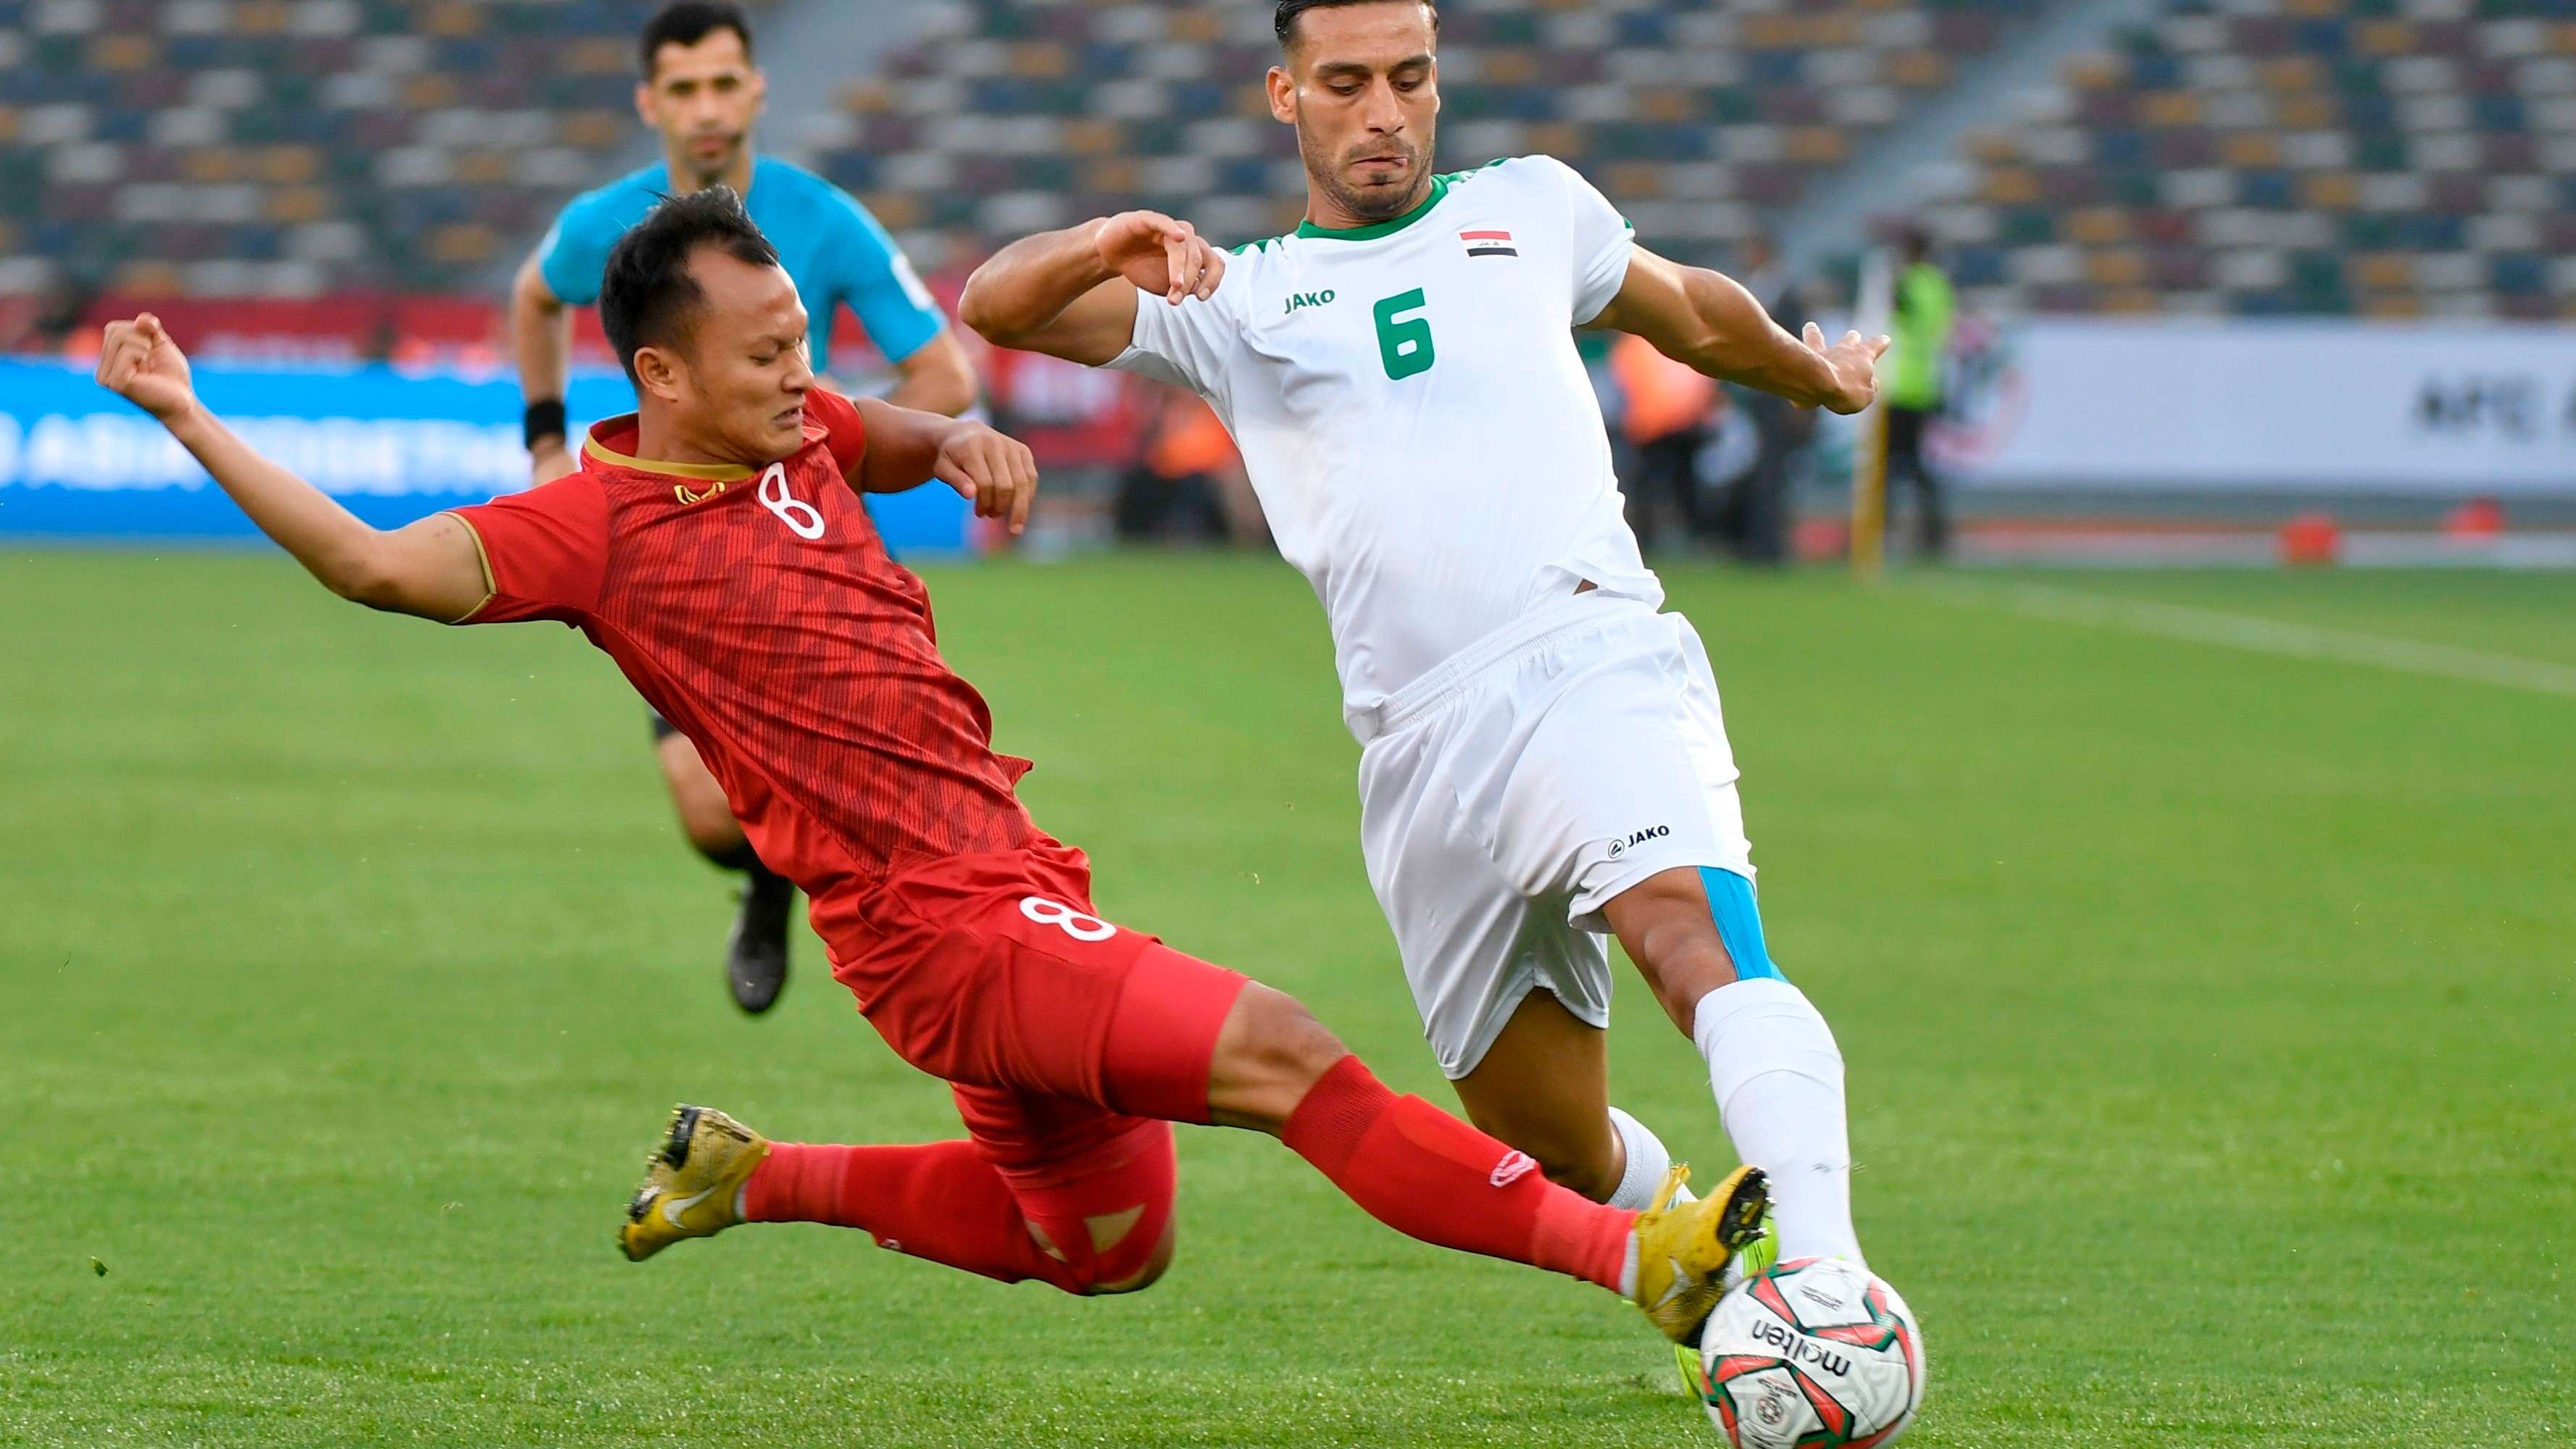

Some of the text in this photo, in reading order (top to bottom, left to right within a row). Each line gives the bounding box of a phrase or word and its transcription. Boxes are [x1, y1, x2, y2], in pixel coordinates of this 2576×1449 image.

[1284, 289, 1335, 314] JAKO
[1373, 287, 1435, 380] 6
[758, 462, 825, 539] 8
[1628, 825, 1670, 848] JAKO
[1019, 896, 1117, 941] 8
[1751, 1319, 1851, 1377] molten
